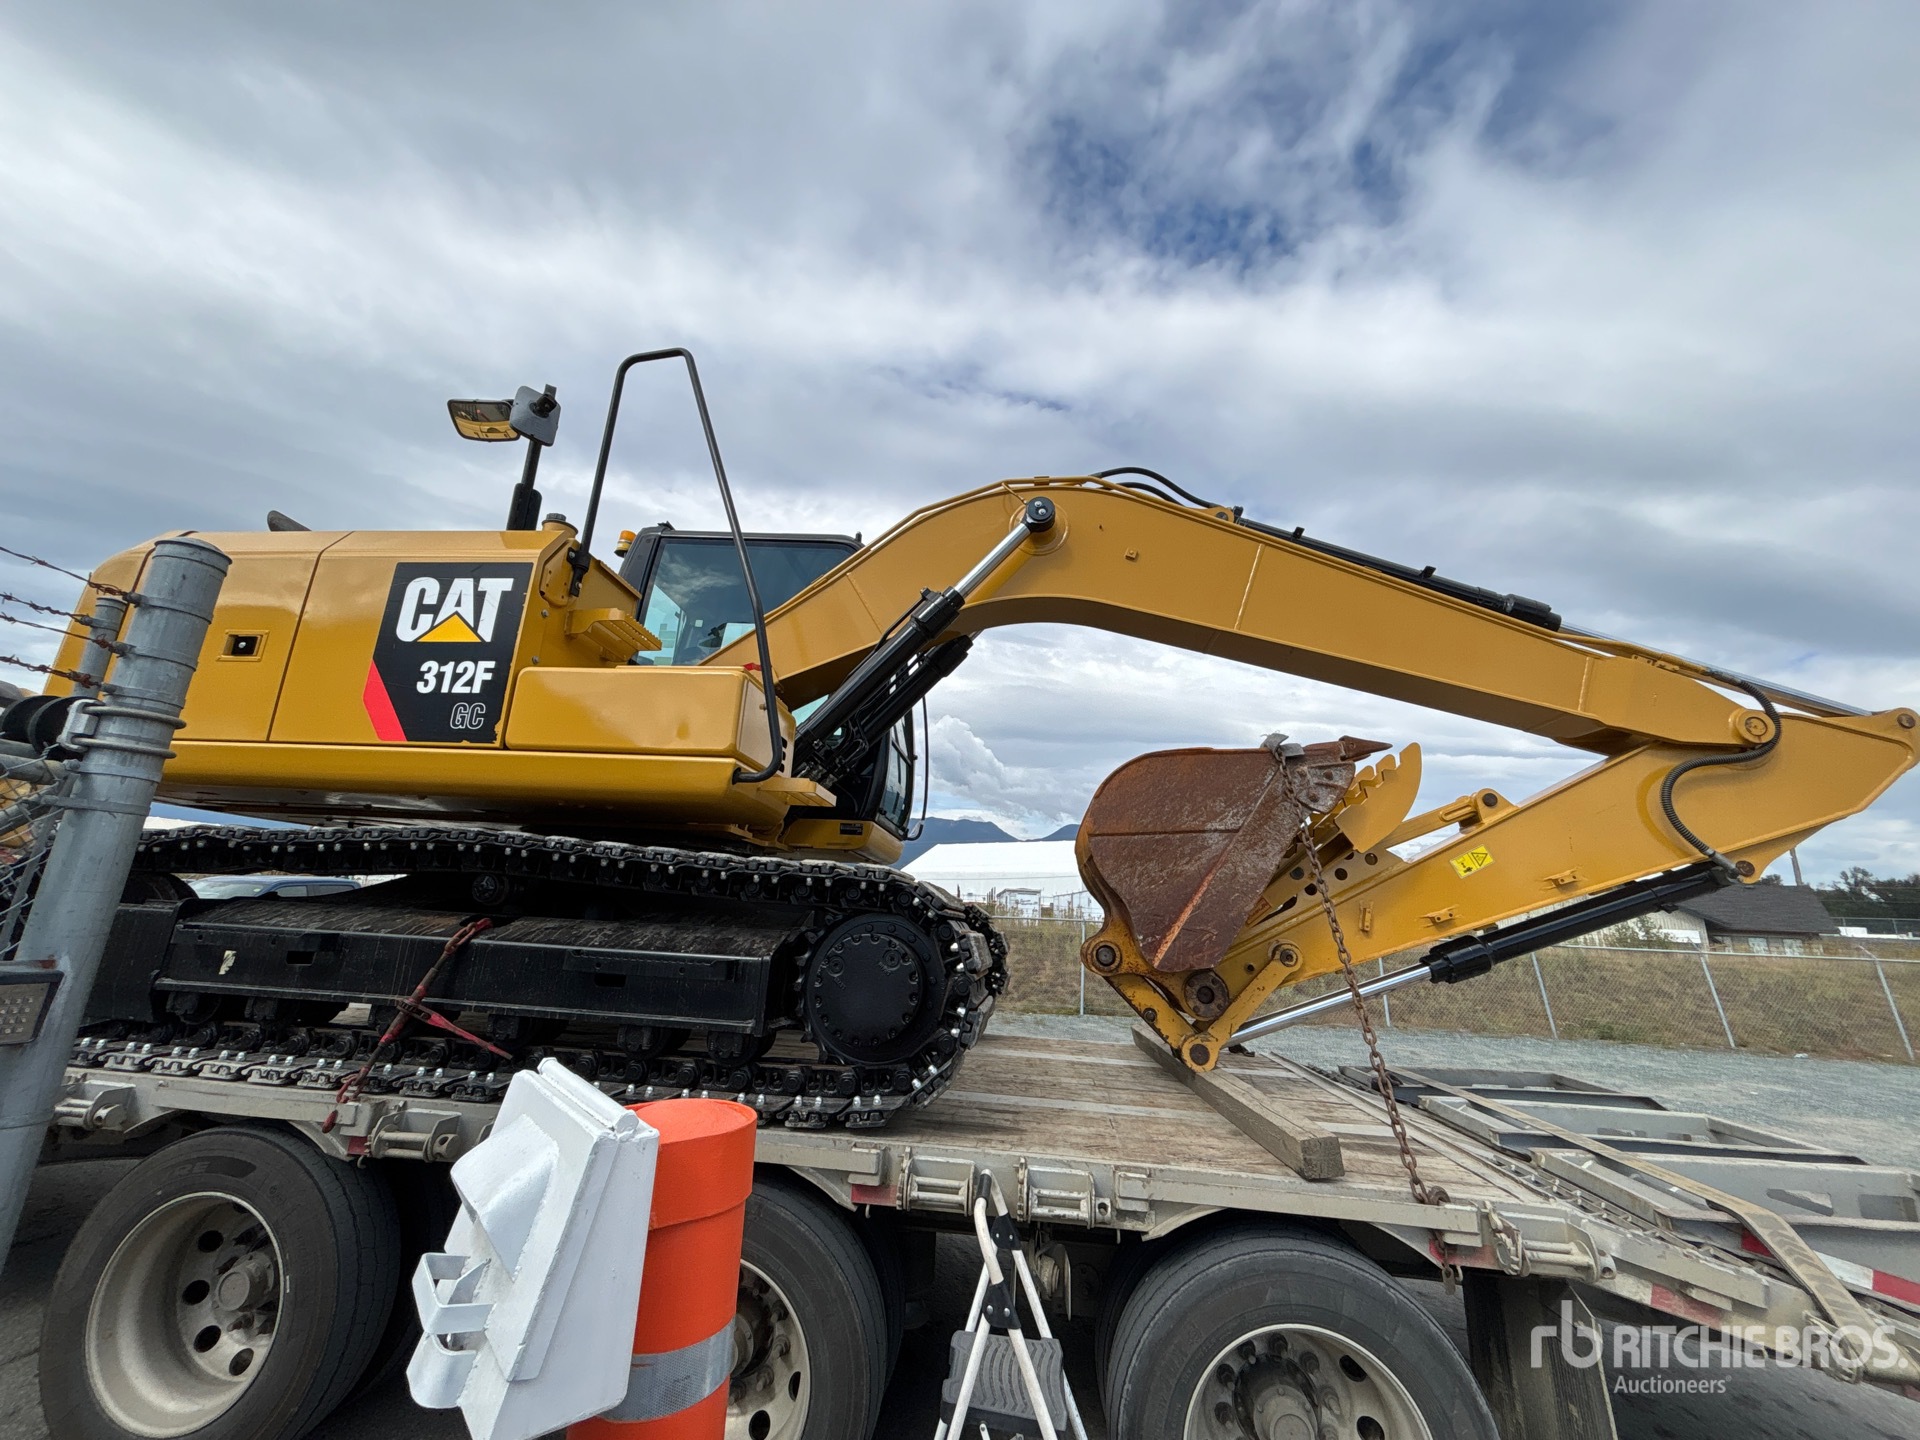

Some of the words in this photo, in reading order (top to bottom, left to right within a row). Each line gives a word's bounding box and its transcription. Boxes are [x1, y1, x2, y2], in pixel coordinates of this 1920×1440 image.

[396, 577, 514, 642] CAT
[416, 660, 496, 693] 312F
[450, 702, 486, 729] GC
